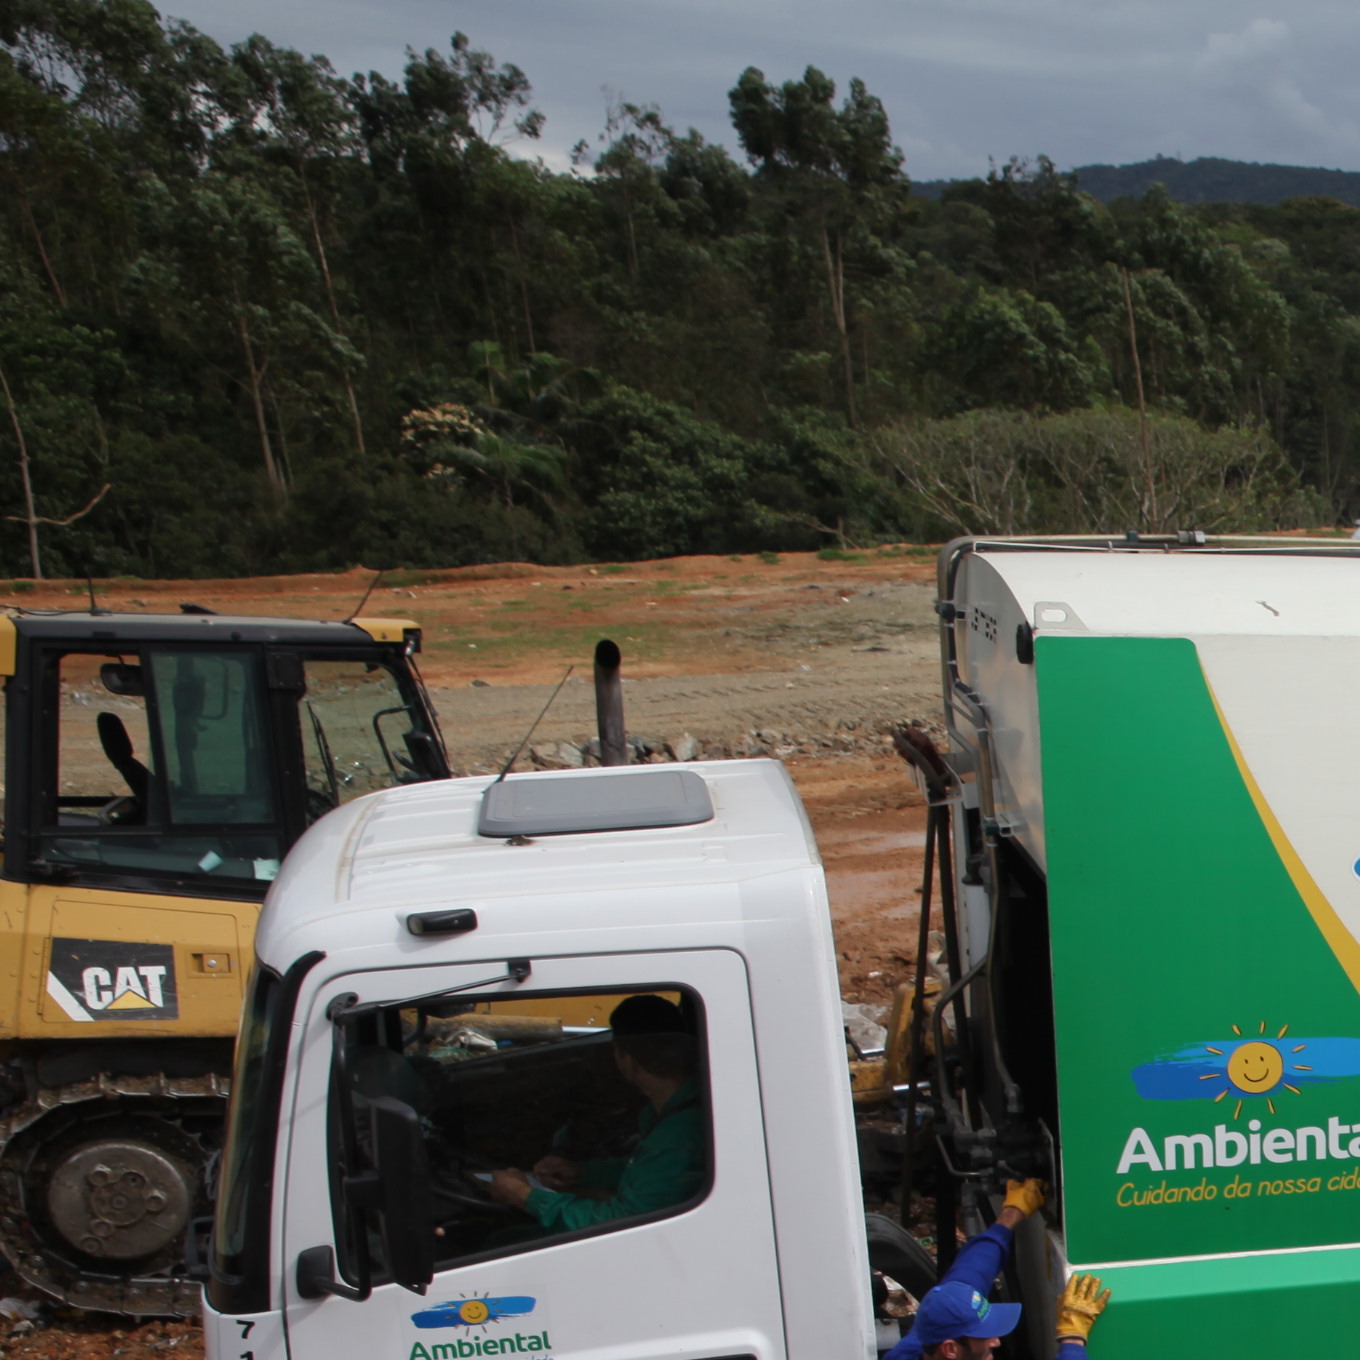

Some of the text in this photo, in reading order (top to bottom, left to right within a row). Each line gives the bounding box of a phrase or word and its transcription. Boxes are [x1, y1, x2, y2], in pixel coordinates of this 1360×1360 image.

[82, 965, 166, 1009] CAT
[1116, 1174, 1218, 1208] Cuidando
[1222, 1172, 1253, 1199] da
[1258, 1175, 1322, 1196] nossa
